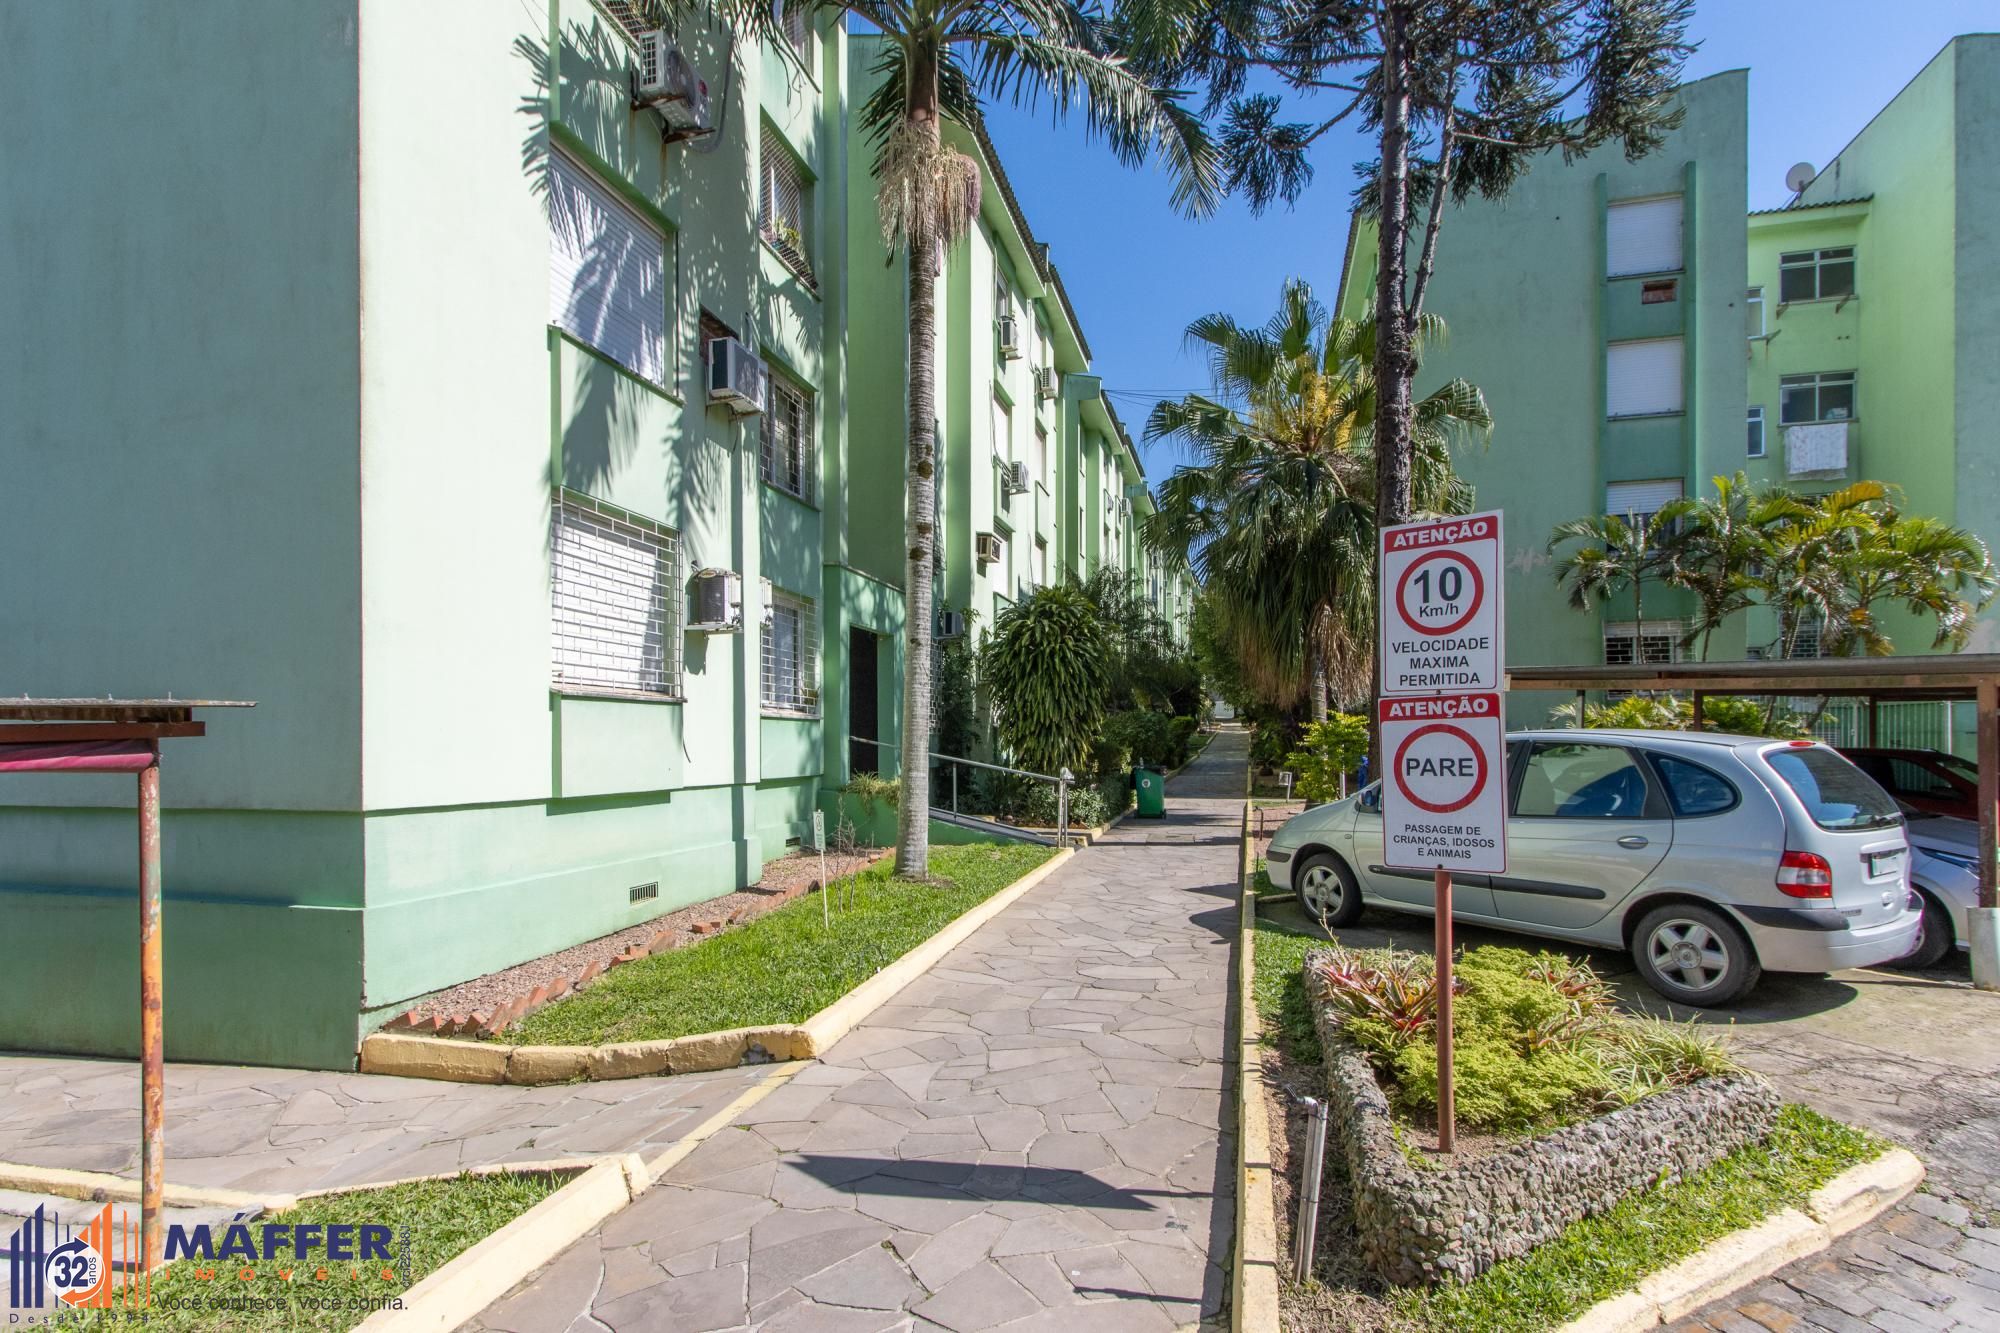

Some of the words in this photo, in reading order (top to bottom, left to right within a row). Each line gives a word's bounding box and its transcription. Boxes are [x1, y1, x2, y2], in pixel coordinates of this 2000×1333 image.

[1393, 521, 1488, 547] ATENÇÃO
[1414, 567, 1462, 603] 10
[1419, 603, 1459, 618] Km/h
[1392, 637, 1489, 654] VELOCIDADE
[1410, 656, 1469, 669] MAXIMA
[1400, 672, 1480, 686] PERMITIDA
[1389, 696, 1489, 718] ATENÇÃO
[1406, 758, 1474, 777] PARE
[1405, 824, 1463, 835] PASSAGEM
[1466, 826, 1481, 836] DE
[1393, 835, 1449, 848] CRIANÇAS,
[1452, 838, 1495, 848] IDOSOS
[1418, 848, 1424, 856] E
[1427, 848, 1471, 859] ANIMAIS
